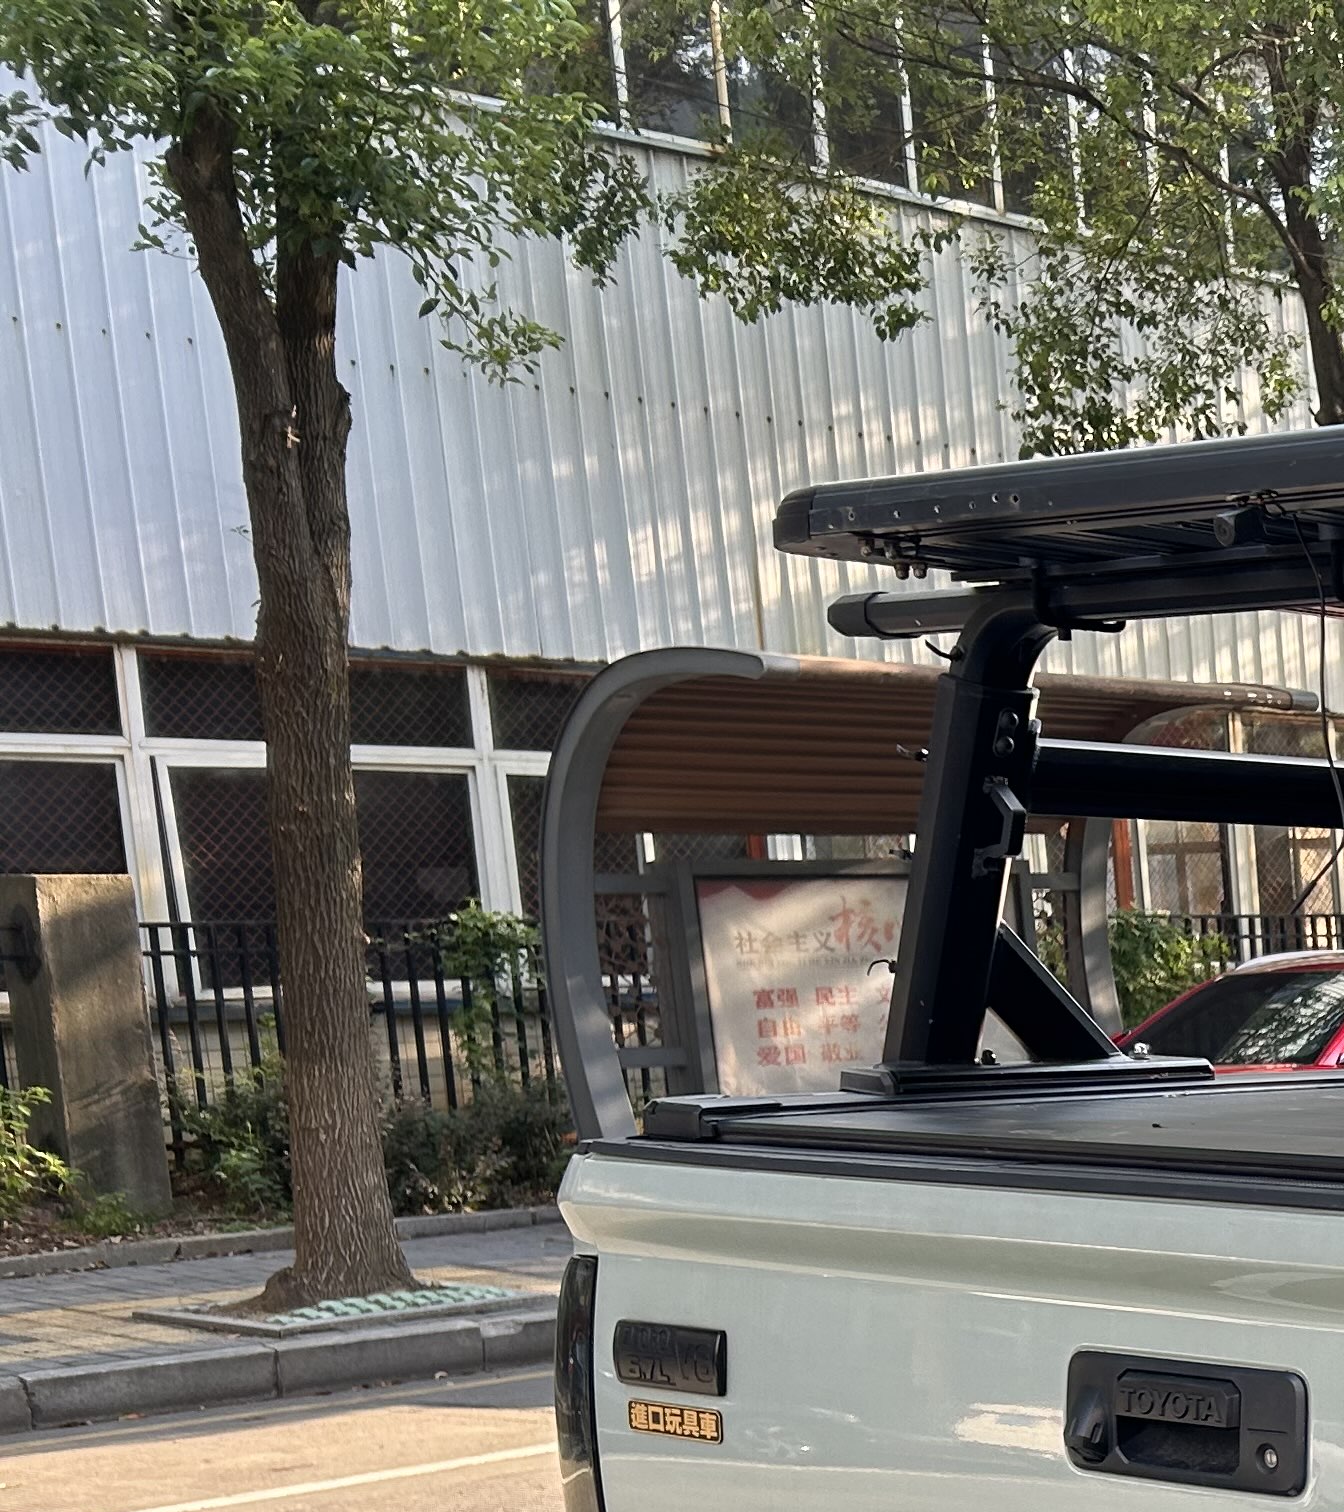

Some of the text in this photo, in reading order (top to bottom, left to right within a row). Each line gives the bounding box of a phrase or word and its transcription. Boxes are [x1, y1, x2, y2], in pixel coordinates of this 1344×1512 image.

[735, 896, 899, 953] 社会主义核
[753, 986, 799, 1010] 富强
[757, 1043, 807, 1067] 爱国
[630, 1402, 718, 1439] 進口玩具車
[1121, 1387, 1222, 1424] TOYOTA
